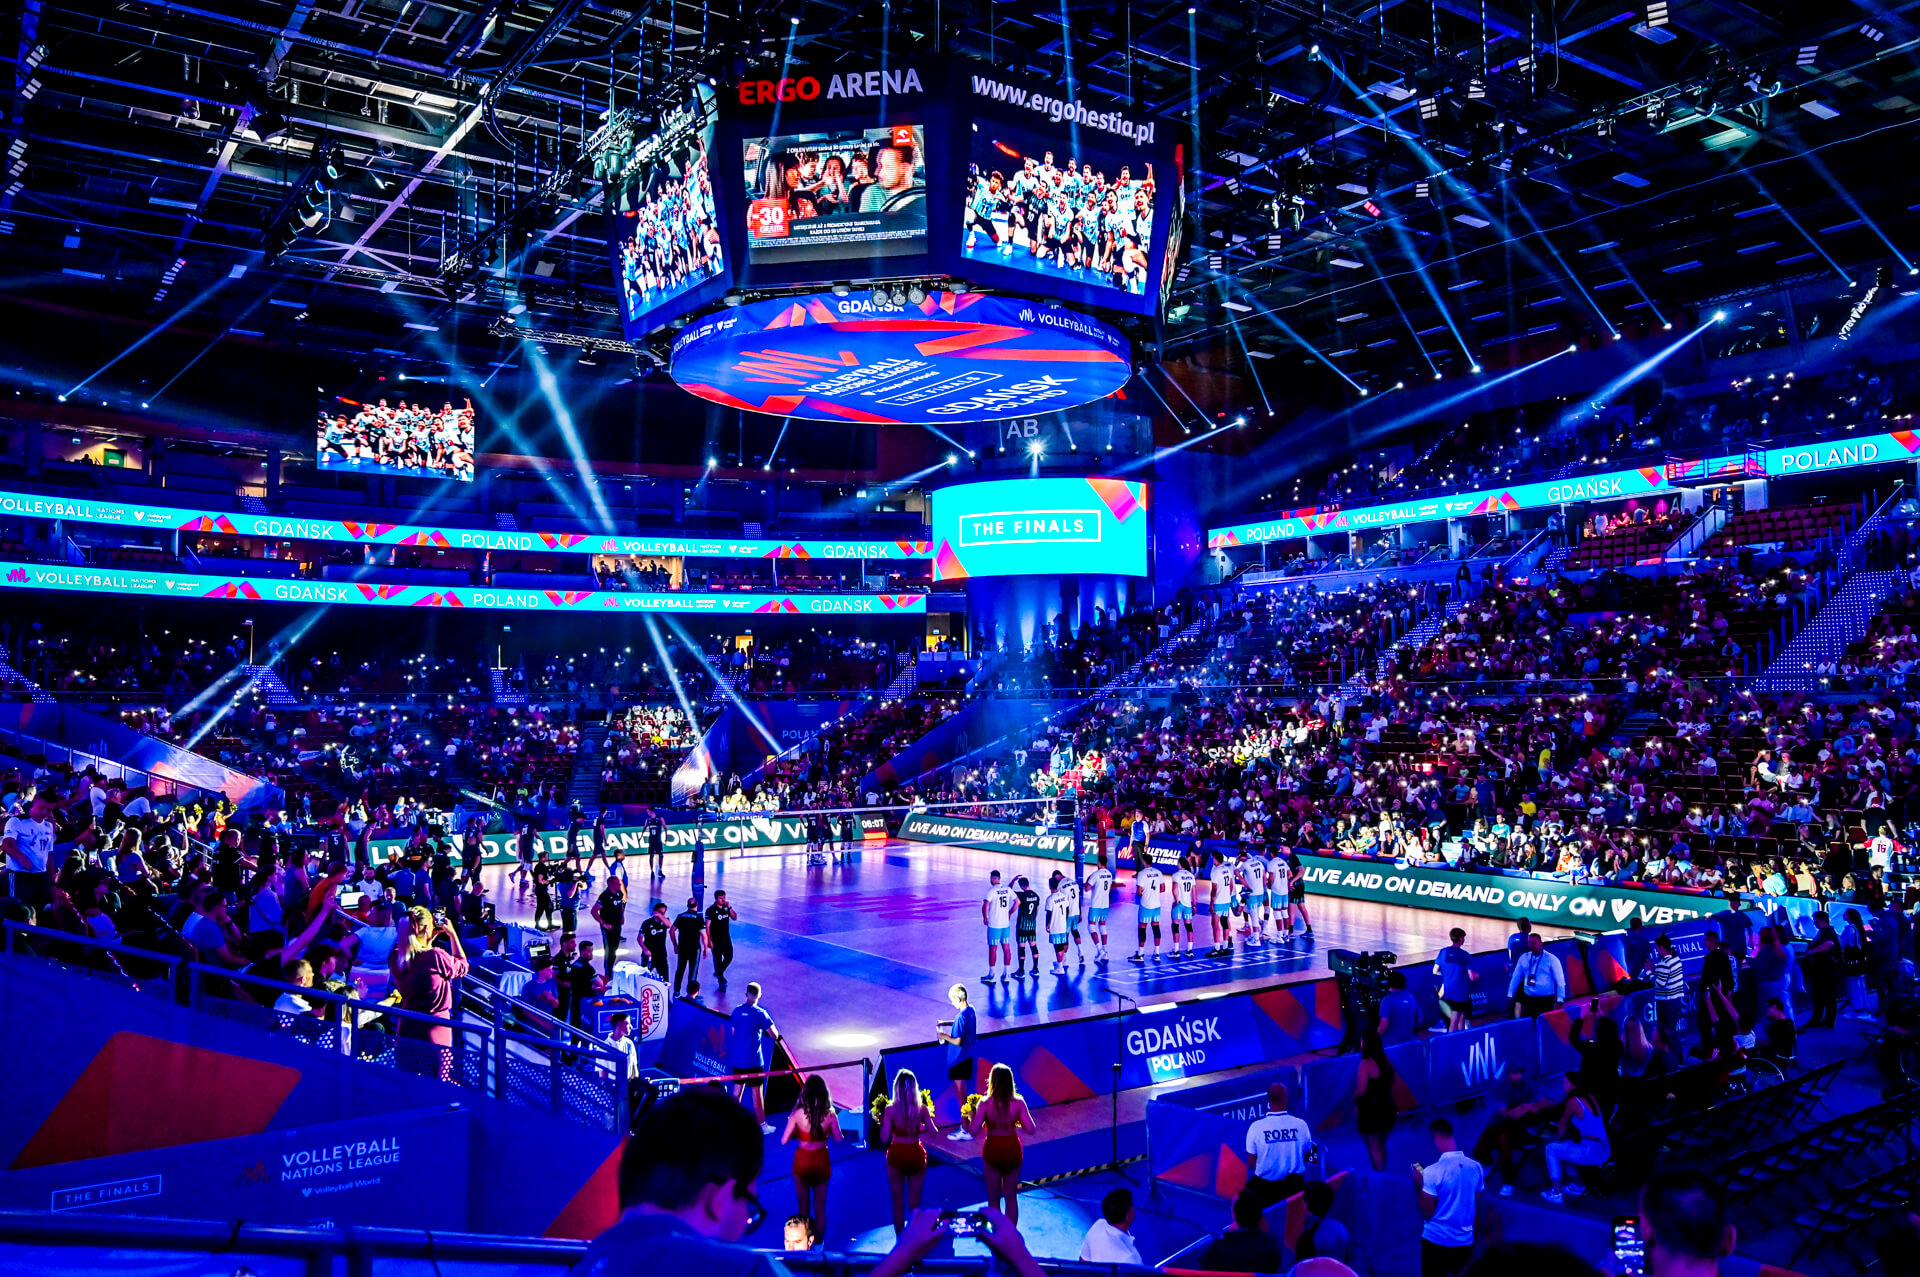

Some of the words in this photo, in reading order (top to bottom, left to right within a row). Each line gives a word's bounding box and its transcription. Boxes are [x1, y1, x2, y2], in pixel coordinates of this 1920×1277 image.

[739, 76, 821, 105] ERGO
[826, 68, 923, 99] ARENA
[972, 75, 1156, 146] www.ergohestia.pl
[1038, 313, 1094, 336] VOLLEYBALL
[797, 358, 911, 393] VOLLEYBALL
[871, 360, 928, 380] LEAGUE
[895, 392, 926, 402] THE
[928, 376, 981, 397] FINALS
[926, 374, 1077, 415] GDAŃSK
[983, 390, 1068, 412] POLAND
[1006, 418, 1039, 440] AB
[1781, 442, 1879, 472] POLAND
[1547, 477, 1623, 502] GDAŃSK
[96, 507, 125, 515] NATIONS
[96, 513, 121, 521] LEAGUE
[1352, 507, 1417, 525] VOLLEYBALL
[253, 517, 334, 540] GDAŃSK
[972, 521, 1004, 536] THE
[1014, 518, 1084, 534] FINALS
[1246, 523, 1295, 542] POLAND
[461, 534, 532, 550] POLAND
[623, 541, 698, 553] VOLLEYBALL
[823, 541, 889, 559] GDAŃSK
[36, 571, 128, 588] VOLLEYBALL
[275, 581, 349, 601] GDAŃSK
[473, 594, 539, 608] POLAND
[624, 598, 694, 608] VOLLEYBALL
[811, 596, 873, 613] GDAŃSK
[661, 827, 718, 847] ONLY
[723, 824, 759, 843] ON
[908, 821, 930, 834] LIVE
[929, 824, 952, 837] AND
[950, 826, 967, 839] ON
[965, 828, 1010, 844] DEMAND
[1009, 833, 1038, 847] ONLY
[1037, 836, 1056, 850] ON
[1876, 843, 1887, 853] 16
[1223, 875, 1231, 887] 12
[1253, 867, 1261, 879] 17
[1070, 887, 1077, 899] 3
[1103, 880, 1109, 891] 8
[1150, 879, 1156, 891] 4
[1182, 881, 1192, 893] 10
[1303, 866, 1342, 885] LIVE
[1341, 871, 1383, 890] AND
[1384, 875, 1416, 895] ON
[1416, 879, 1506, 905] DEMAND
[1507, 890, 1567, 912] ONLY
[1569, 896, 1606, 917] ON
[999, 895, 1007, 908] 15
[1028, 902, 1035, 915] 9
[1059, 904, 1064, 916] 1
[1126, 1015, 1223, 1056] GDAŃSK
[694, 1051, 727, 1073] VOLLEYBALL
[1152, 1049, 1206, 1073] POLAND
[1264, 1127, 1299, 1141] FORT
[282, 1136, 400, 1168] VOLLEYBALL
[281, 1161, 343, 1182] NATIONS
[348, 1151, 400, 1170] LEAGUE
[65, 1190, 94, 1205] THE
[98, 1182, 151, 1198] FINALS
[314, 1181, 353, 1195] Volleyball
[354, 1176, 381, 1188] World
